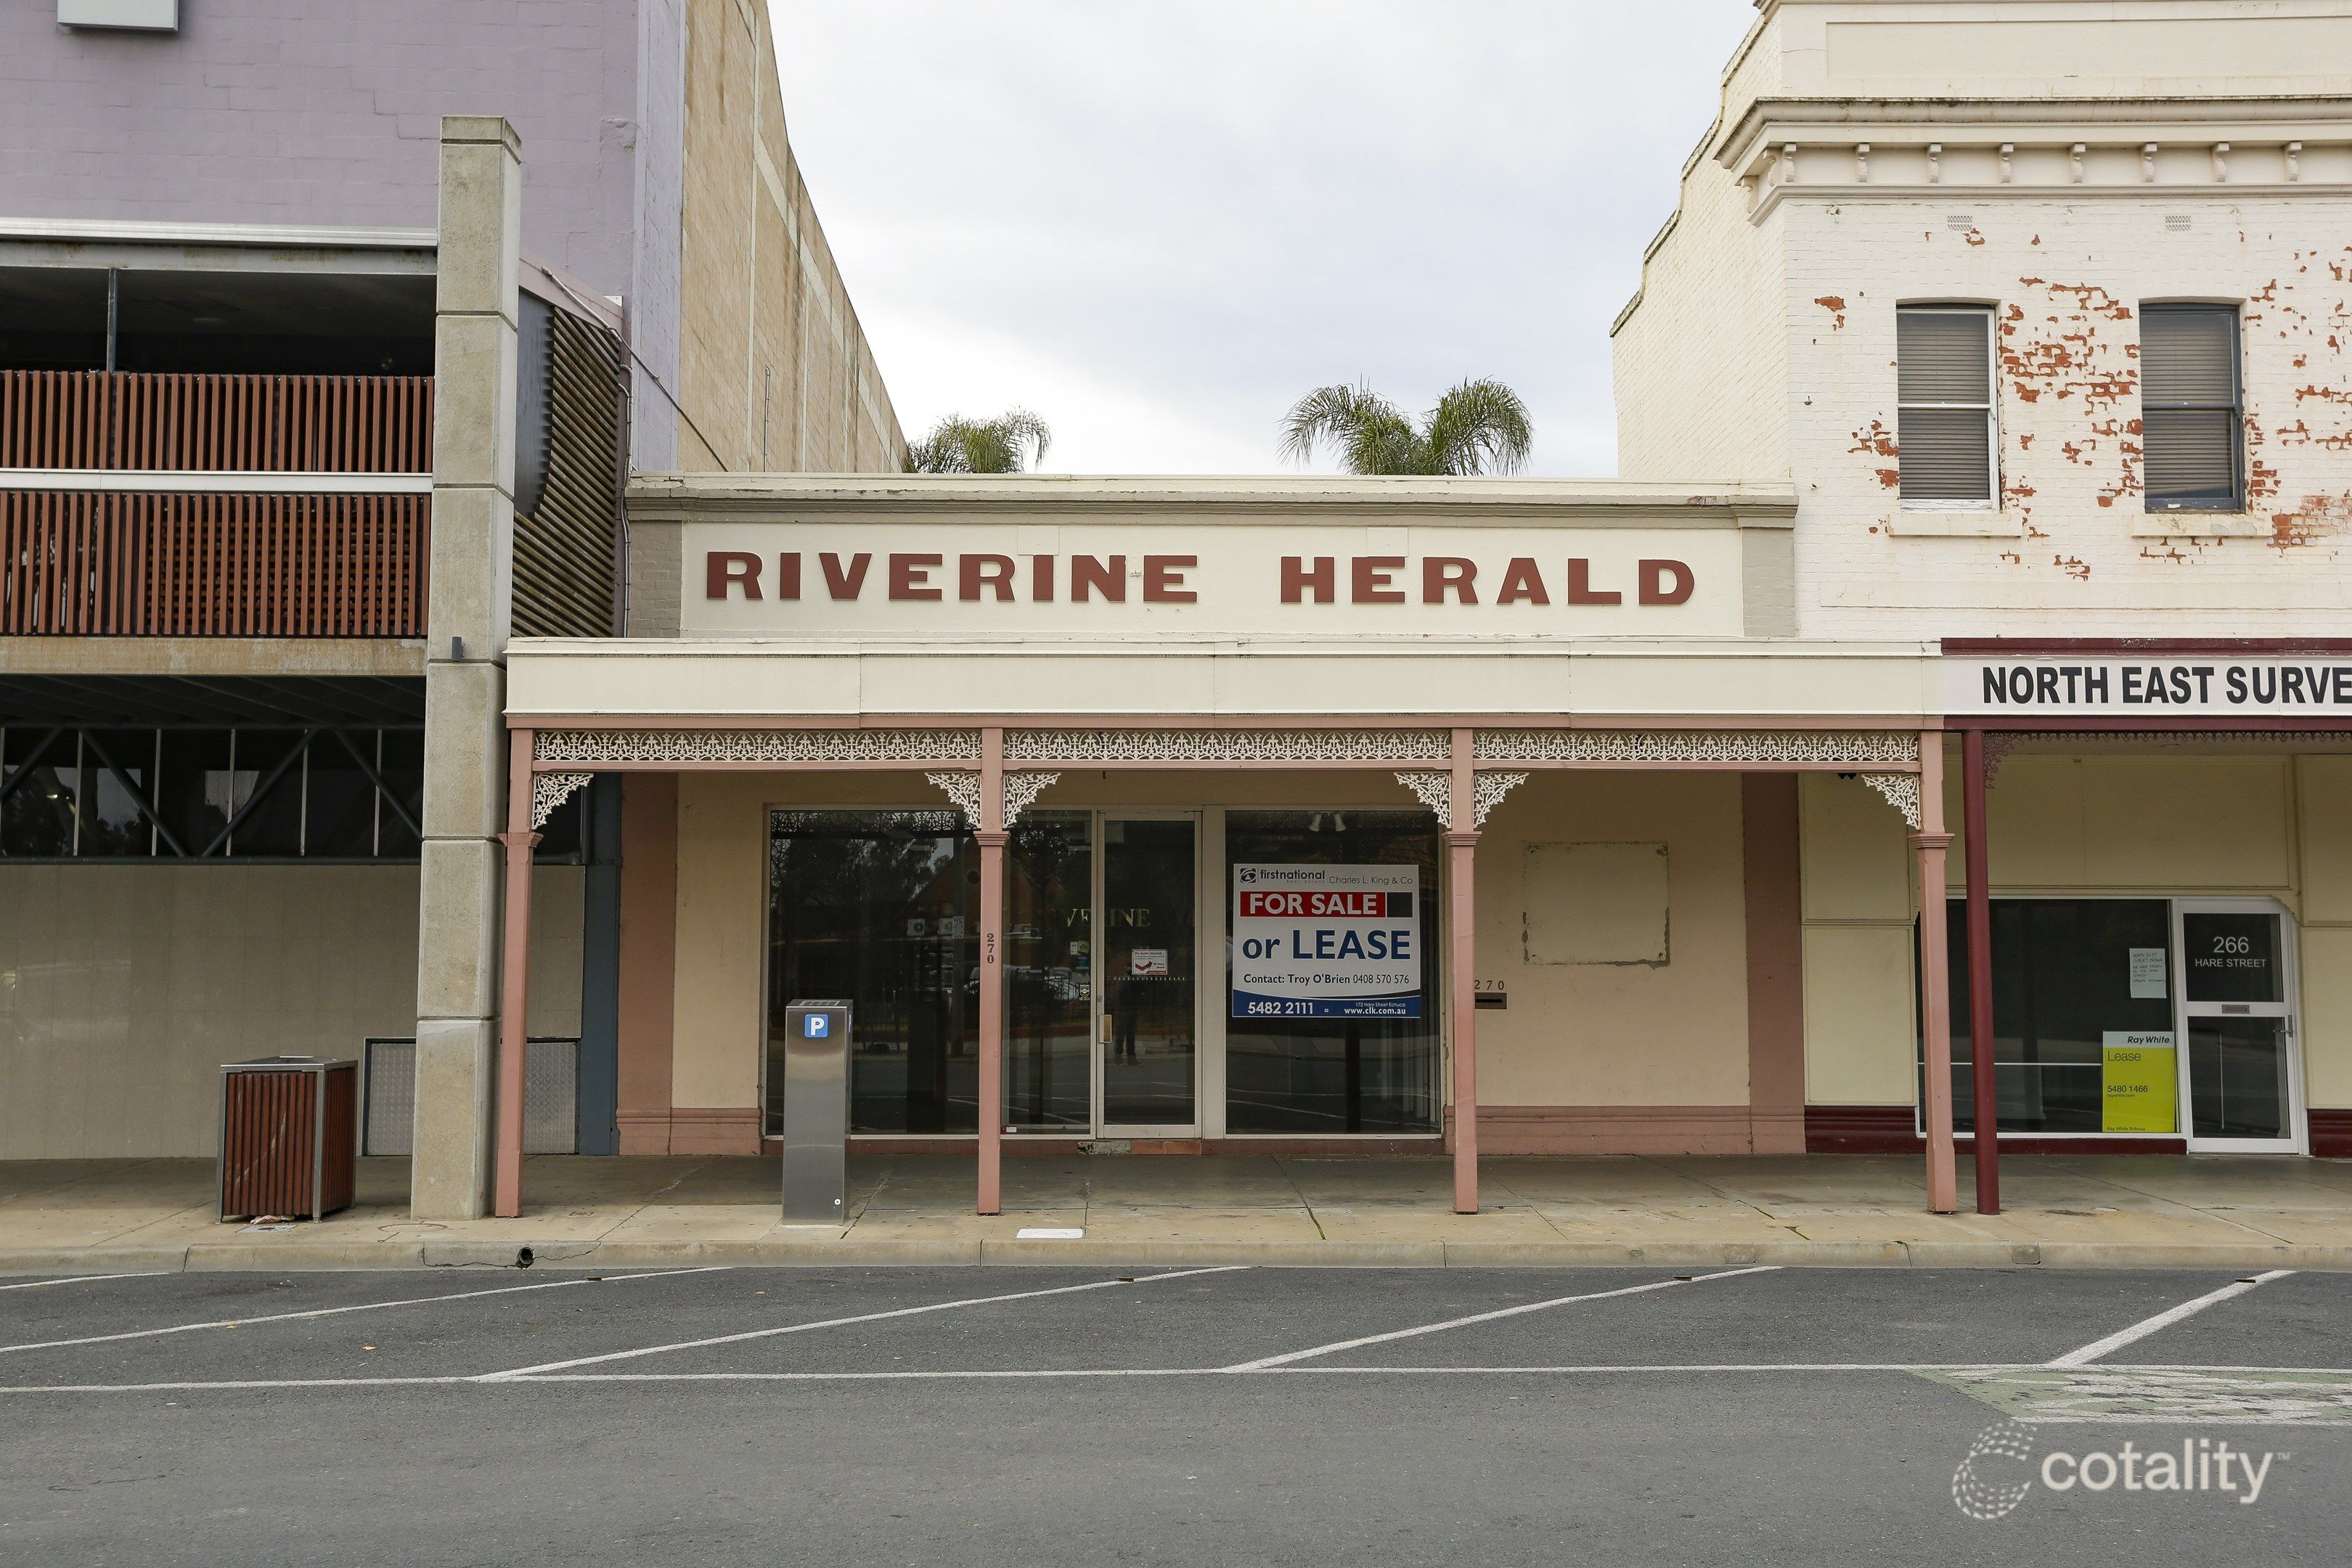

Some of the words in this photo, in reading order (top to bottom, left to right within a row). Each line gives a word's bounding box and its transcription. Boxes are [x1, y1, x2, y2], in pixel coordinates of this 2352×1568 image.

[706, 551, 1199, 604] RIVERINE
[1280, 556, 1695, 605] HERALD
[1983, 666, 2109, 705] NORTH
[2122, 666, 2214, 705] EAST
[2225, 666, 2352, 705] SURVE
[1328, 875, 1360, 884] Charles
[1371, 875, 1389, 886] King
[1400, 876, 1413, 885] Co
[1249, 894, 1304, 915] FOR
[1311, 894, 1377, 915] SALE
[1241, 937, 1281, 960] or
[1292, 929, 1410, 960] LEASE
[2213, 936, 2249, 953] 266
[2195, 958, 2224, 967] HARE
[2226, 958, 2267, 967] STREET
[1244, 973, 1285, 984] Contact:
[1287, 973, 1310, 986] Troy
[1312, 973, 1350, 984] O'Brien
[1352, 974, 1373, 984] 0408
[1376, 974, 1392, 984] 570
[1394, 974, 1410, 984] 576
[1474, 979, 1504, 990] 270
[1247, 1002, 1281, 1014] 5482
[1285, 1002, 1313, 1014] 2111
[810, 1017, 825, 1036] P
[2127, 1036, 2144, 1045] Ray
[2107, 1050, 2141, 1061] Lease
